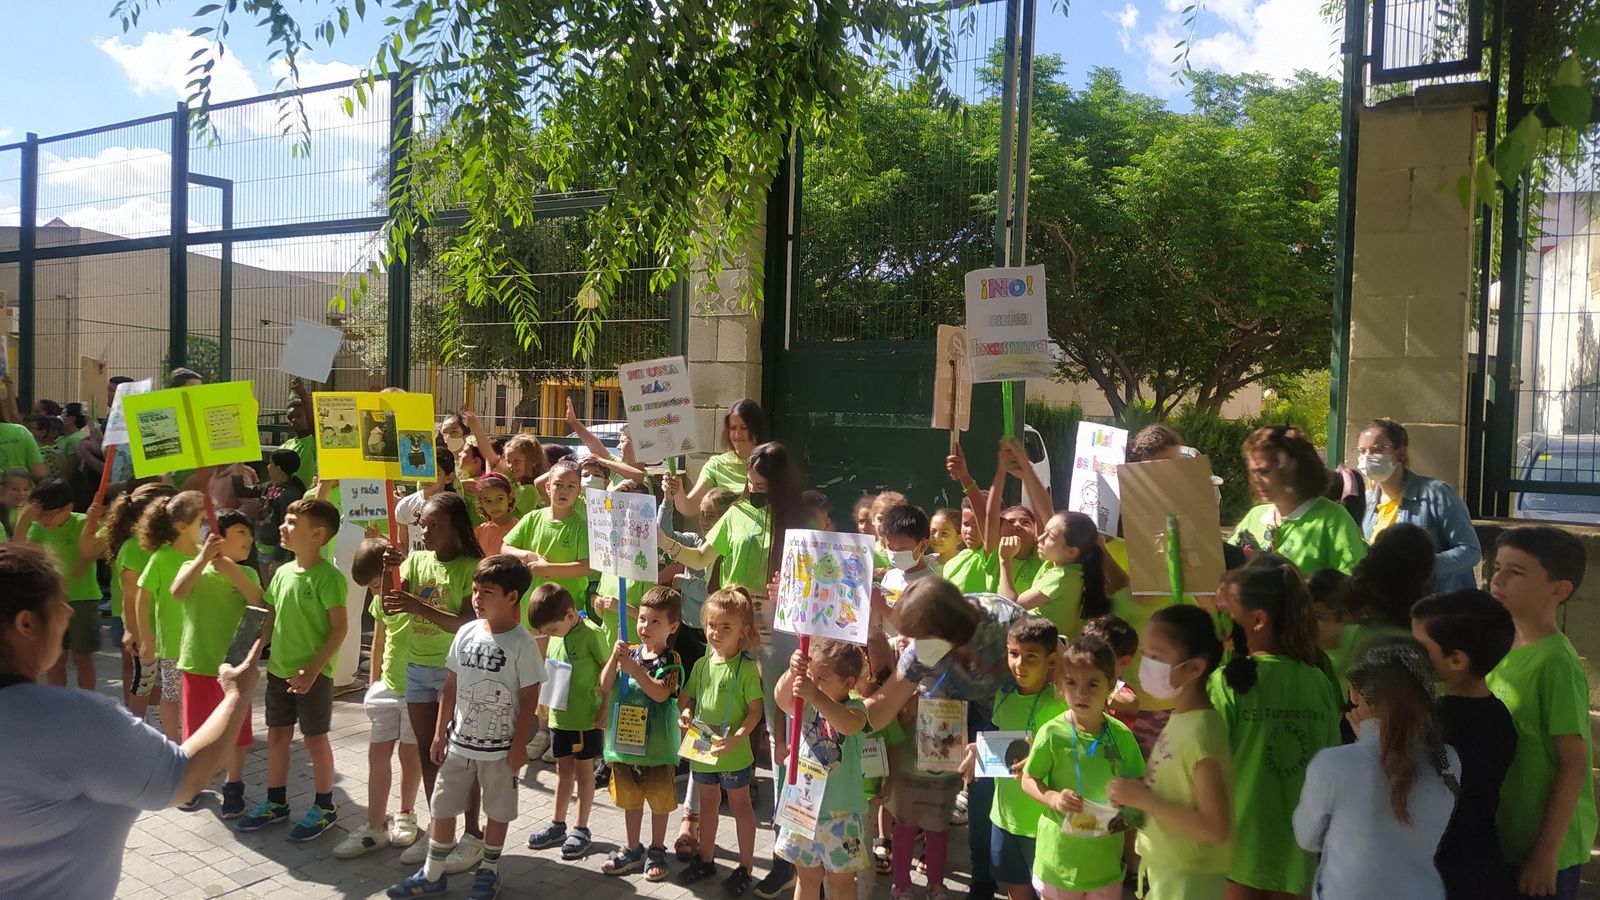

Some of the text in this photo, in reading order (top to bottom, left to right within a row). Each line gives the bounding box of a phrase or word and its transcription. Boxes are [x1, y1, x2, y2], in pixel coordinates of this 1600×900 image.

[981, 276, 1034, 300] ¡NO!
[352, 484, 379, 498] y más
[349, 504, 387, 518] cultura
[461, 639, 504, 659] STAR
[460, 652, 507, 672] WARS
